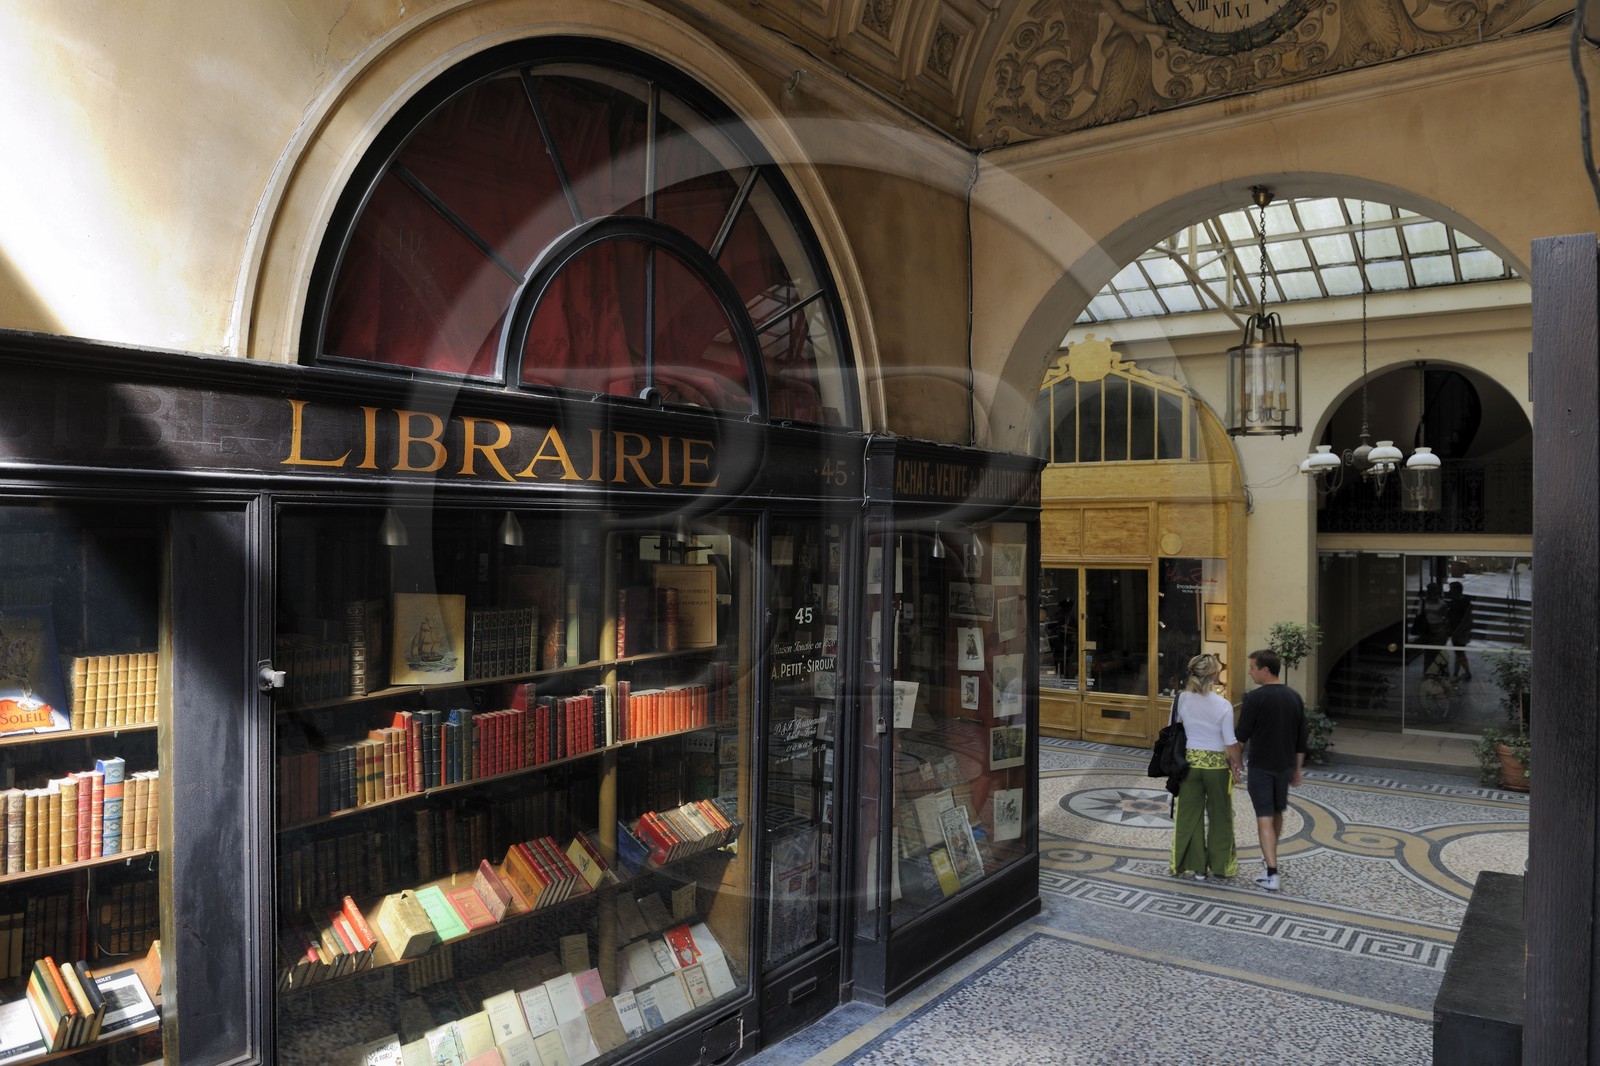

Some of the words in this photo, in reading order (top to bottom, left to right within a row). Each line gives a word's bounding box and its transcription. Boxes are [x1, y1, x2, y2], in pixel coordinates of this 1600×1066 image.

[1212, 1, 1230, 20] VII
[1234, 3, 1250, 20] VI
[281, 399, 720, 488] LIBRAIRIE
[895, 460, 929, 495] ACHAT
[936, 463, 968, 497] VENTE
[795, 606, 813, 625] 45
